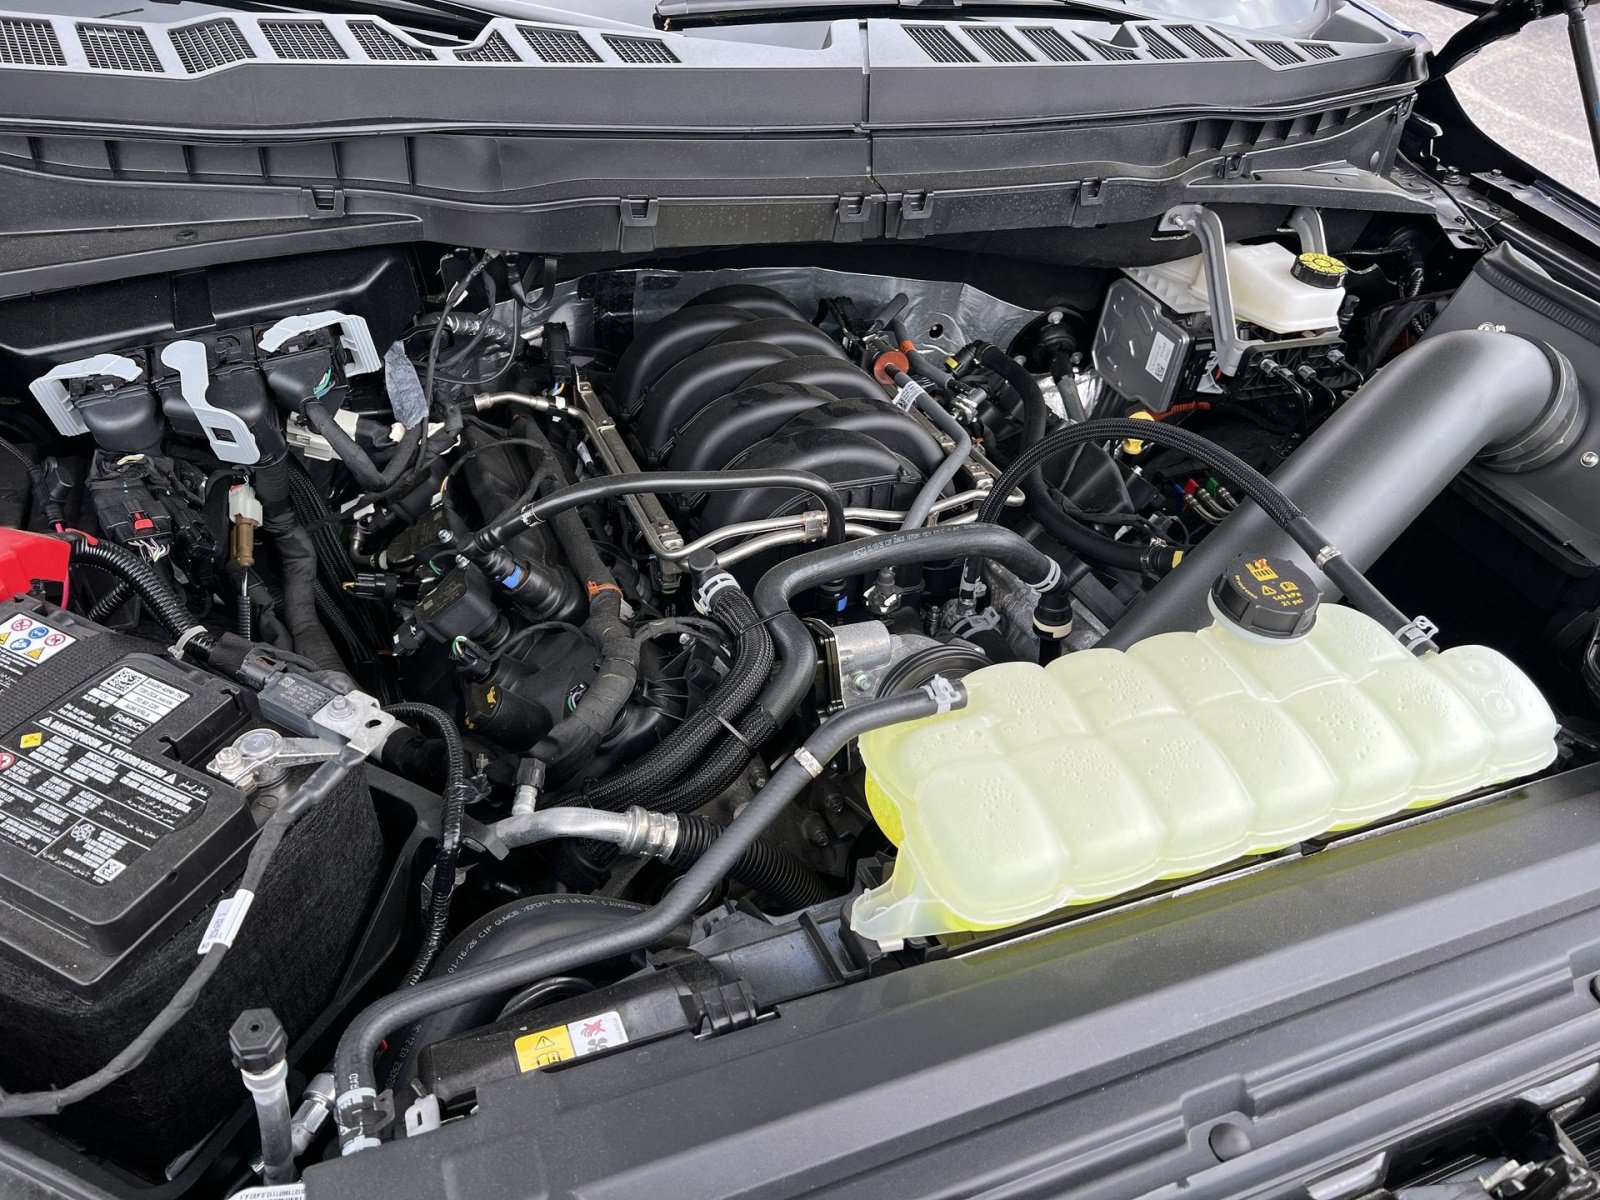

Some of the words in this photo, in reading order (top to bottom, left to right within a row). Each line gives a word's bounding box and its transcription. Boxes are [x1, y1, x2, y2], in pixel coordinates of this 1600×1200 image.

[50, 720, 103, 748] DANGER/POISON
[113, 714, 146, 731] FoMoCo
[110, 748, 168, 778] PELIGRO/VENENO
[447, 939, 478, 974] 01/16/26
[478, 925, 492, 939] CIP
